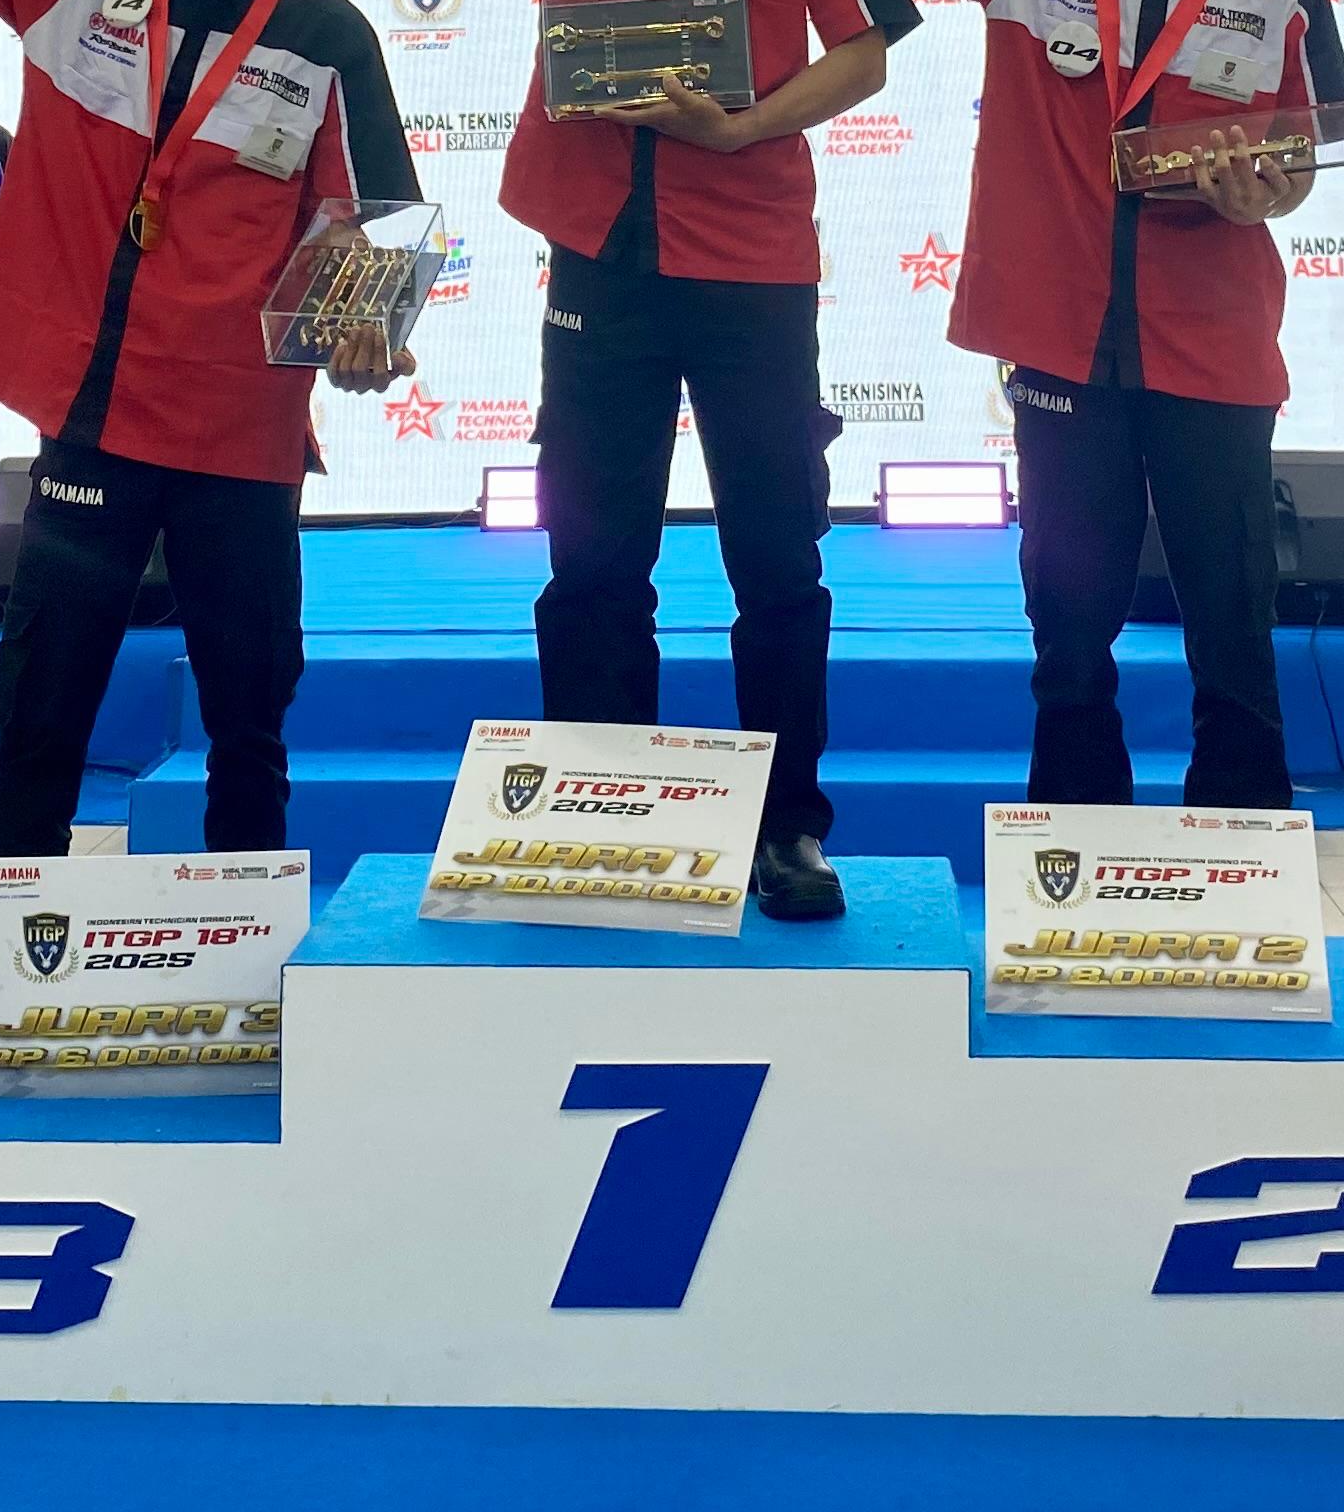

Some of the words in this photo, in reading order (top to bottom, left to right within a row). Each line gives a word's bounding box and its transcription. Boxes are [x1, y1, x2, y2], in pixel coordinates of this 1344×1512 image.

[1049, 40, 1098, 62] 04
[404, 114, 453, 131] ANDAL
[831, 114, 900, 127] YAMAHA
[408, 133, 442, 153] SLI
[827, 129, 914, 142] TECHNICAL
[823, 143, 905, 156] ACADEMY
[1293, 256, 1344, 278] ASLI
[428, 282, 470, 301] MK
[830, 383, 924, 402] TEKNISINYA
[460, 399, 529, 412] YAMAHA
[1027, 390, 1074, 415] YAMAHA
[456, 413, 534, 426] TECHNICA
[453, 427, 530, 440] ACADEMY
[52, 482, 104, 506] YAMAHA
[490, 727, 531, 738] YAMAHA
[505, 772, 540, 787] ITGP
[554, 781, 646, 796] ITGP
[658, 786, 729, 801] 18TH
[550, 799, 654, 816] 2025
[1006, 810, 1051, 822] YAMAHA
[453, 838, 677, 874] JUARA
[686, 849, 720, 877] 1
[1039, 860, 1077, 875] ITGP
[1095, 866, 1191, 882] ITGP
[1206, 868, 1279, 884] 18TH
[431, 872, 497, 890] RP
[502, 874, 743, 906] 10.000.000
[1096, 886, 1206, 901] 2025
[27, 925, 66, 943] ITGP
[83, 929, 183, 949] ITGP
[197, 925, 271, 946] 18TH
[1004, 929, 1242, 962] JUARA
[1254, 934, 1308, 963] 2
[84, 952, 196, 970] 2025
[993, 965, 1060, 985] RP
[1067, 966, 1311, 991] 8.000.000
[240, 1001, 280, 1033] 3
[550, 1063, 770, 1309] 1
